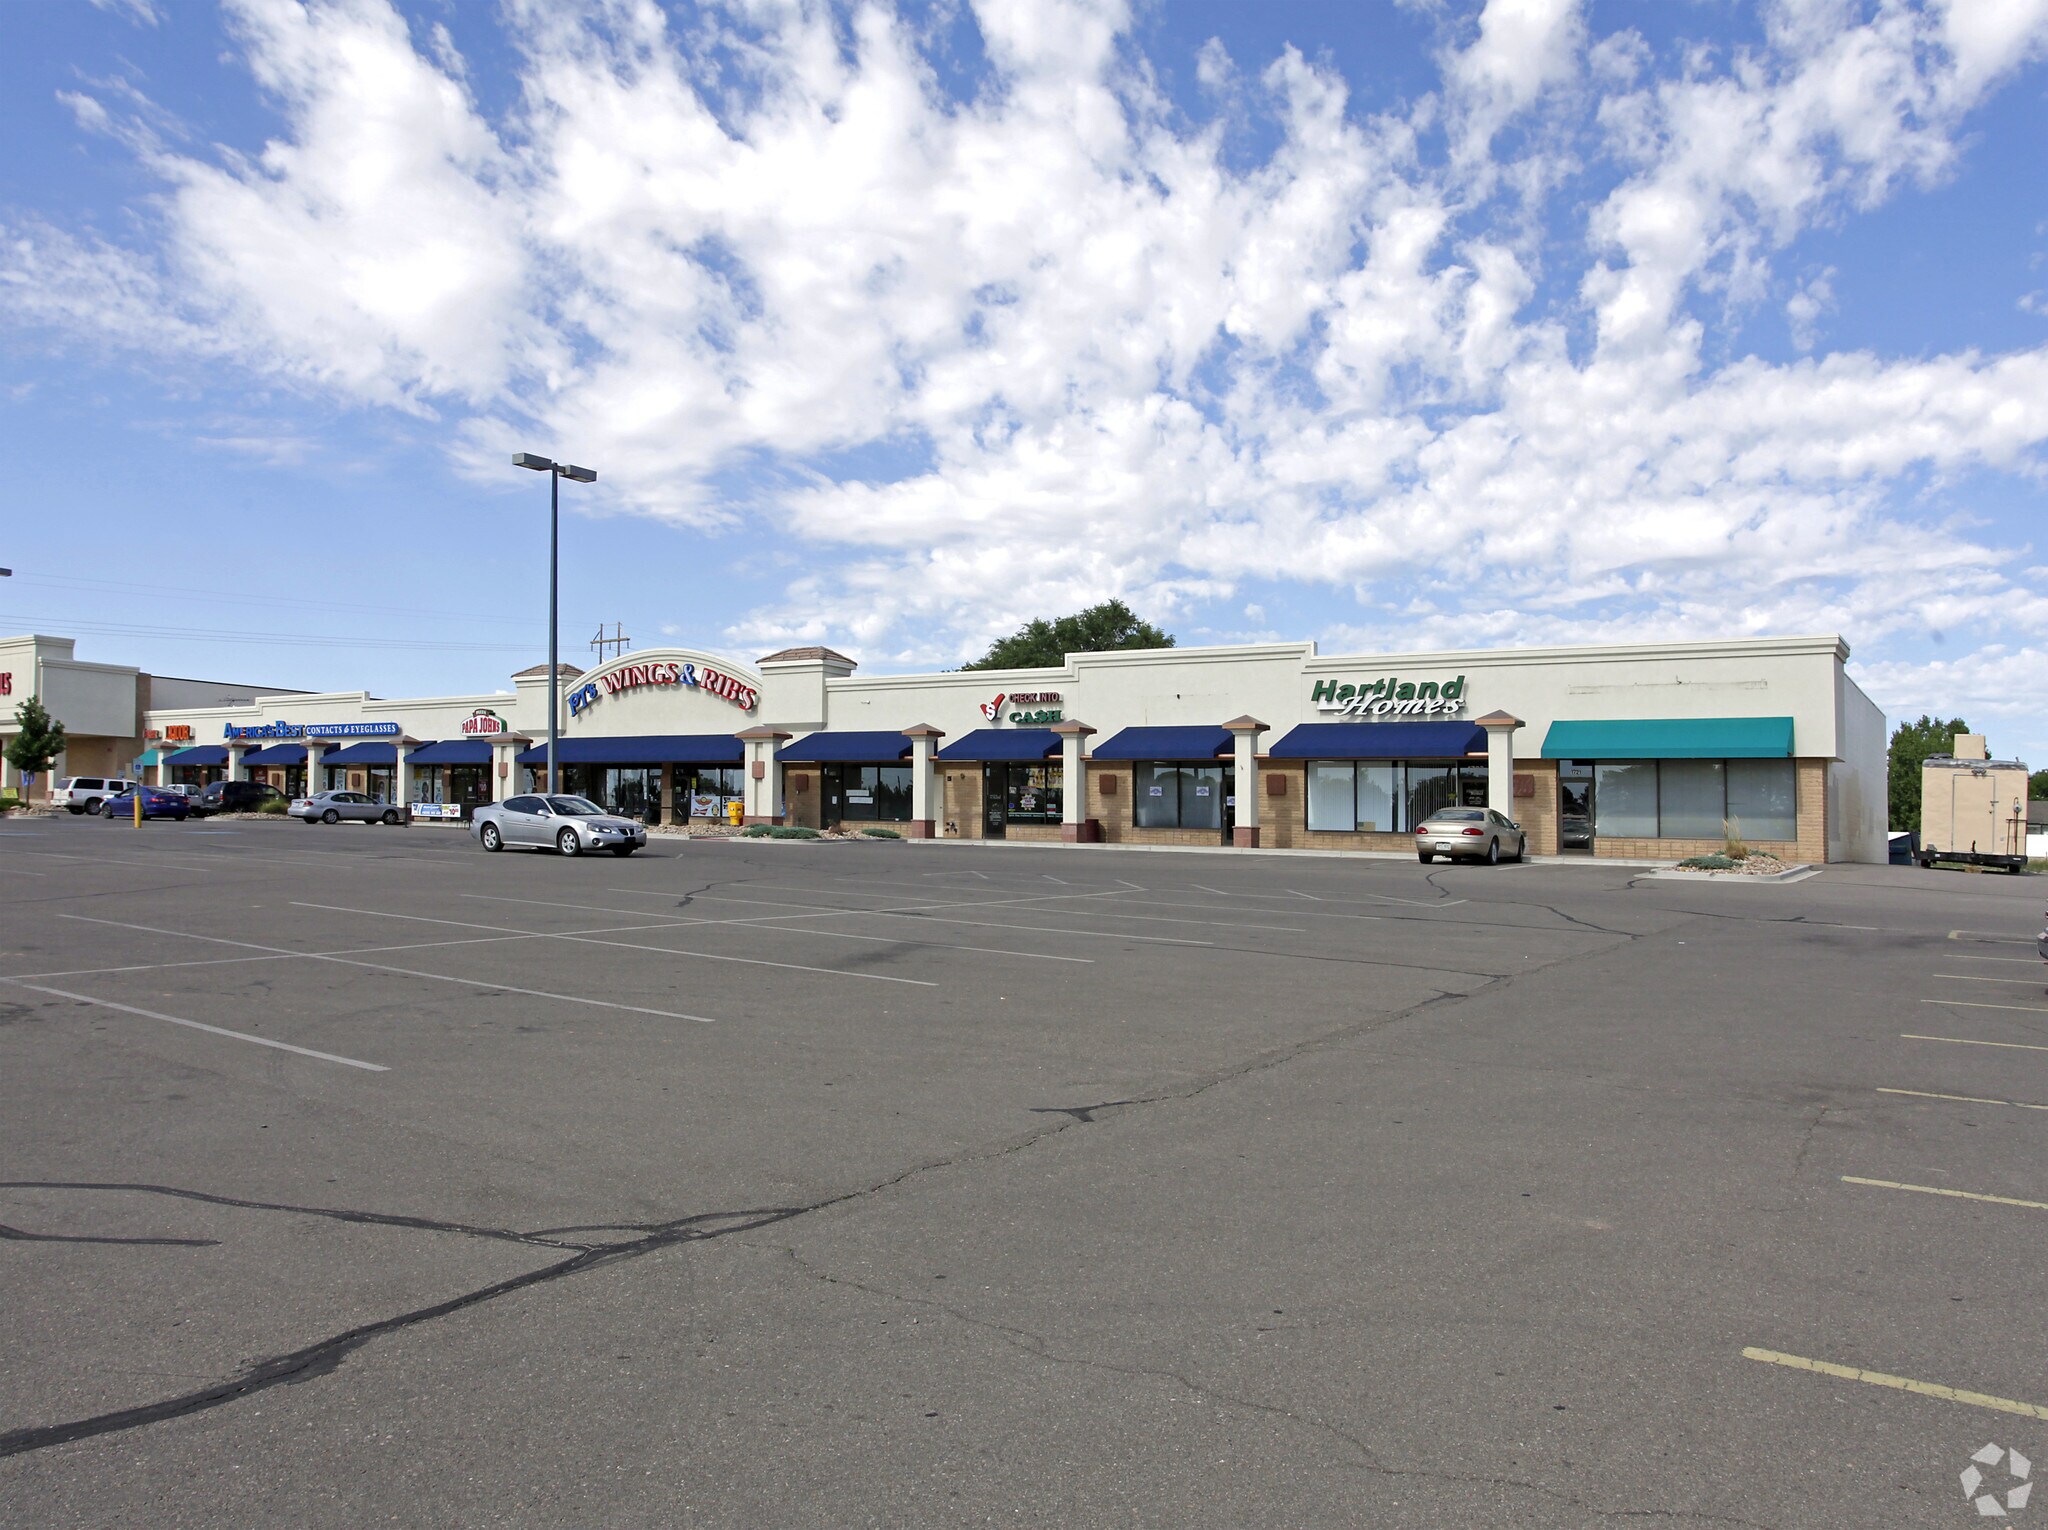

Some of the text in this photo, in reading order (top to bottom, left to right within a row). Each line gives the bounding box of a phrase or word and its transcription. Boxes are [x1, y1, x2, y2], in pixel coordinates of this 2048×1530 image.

[601, 663, 679, 695] WINGS
[679, 663, 696, 686] &
[699, 667, 757, 711] RIB'S
[1311, 675, 1465, 702] Hartland
[1009, 693, 1038, 703] CHECK
[1334, 694, 1465, 716] Homes
[224, 720, 305, 739] AMERICA'S BEST
[306, 725, 342, 735] CONTACTS
[350, 724, 396, 734] EYEGLASSES
[462, 718, 478, 733] PAPA
